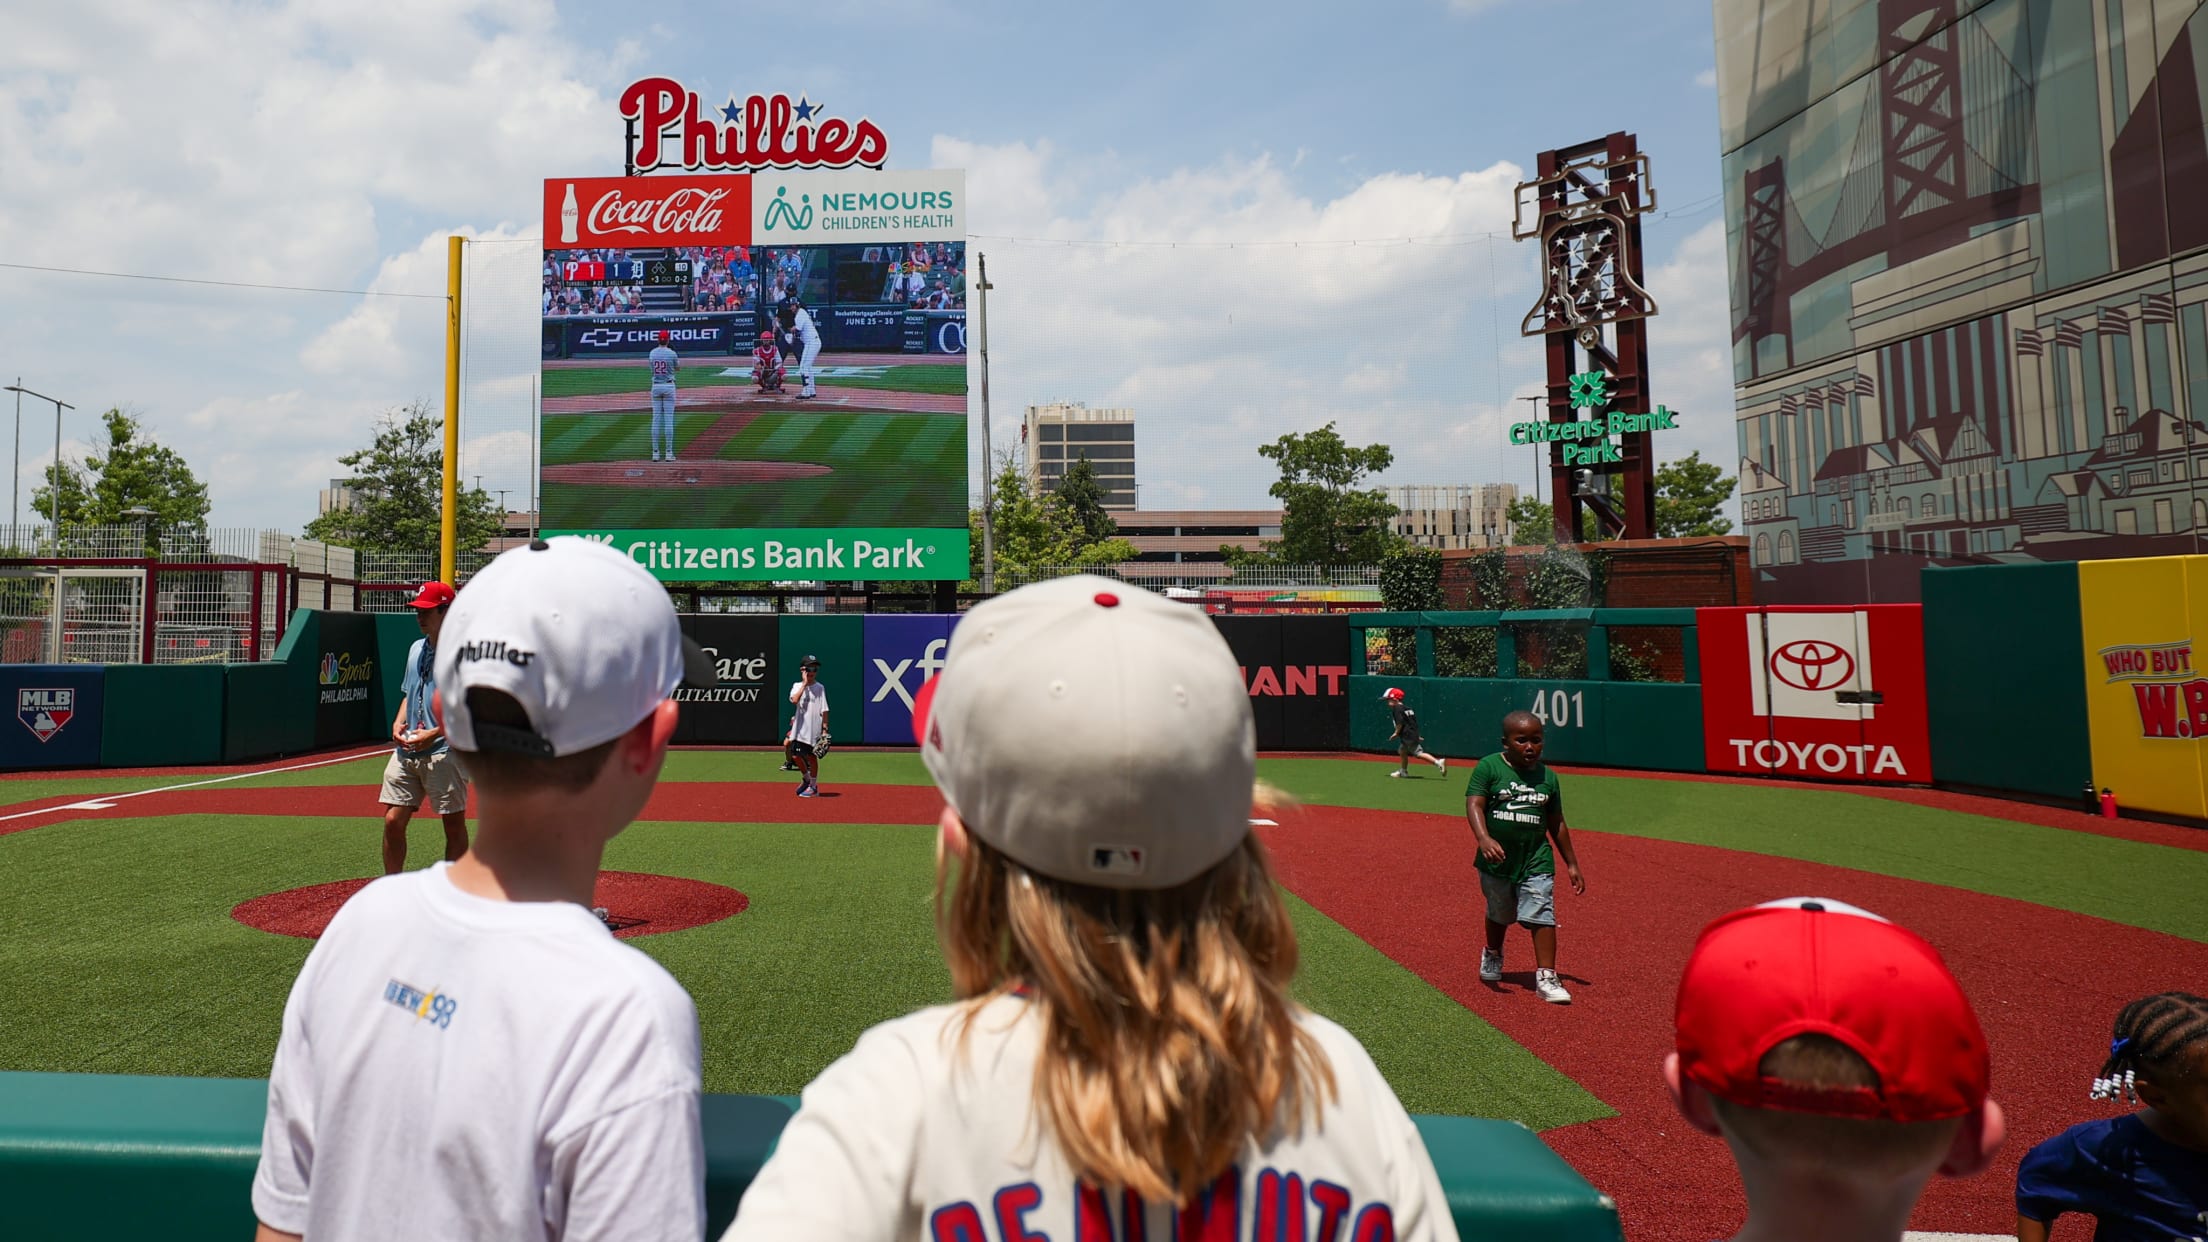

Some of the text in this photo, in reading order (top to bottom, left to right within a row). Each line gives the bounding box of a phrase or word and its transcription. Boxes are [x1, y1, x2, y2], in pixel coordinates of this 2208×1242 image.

[617, 77, 889, 169] Phillies
[587, 187, 732, 235] Coca-Cola
[822, 191, 953, 212] NEMOURS
[822, 214, 953, 231] CHILDREN'S HEALTH
[627, 328, 720, 342] CHEROLET
[1509, 404, 1679, 445] Citizens Bank
[1562, 438, 1623, 467] Park
[627, 540, 756, 570] Citizens
[764, 539, 845, 569] Bank
[338, 652, 373, 690] Sports
[2103, 646, 2192, 676] WHO BUT
[21, 691, 71, 706] MLB
[320, 687, 368, 704] PHILADELPHIA
[1531, 689, 1583, 727] 401
[1729, 739, 1907, 776] TOYOTA
